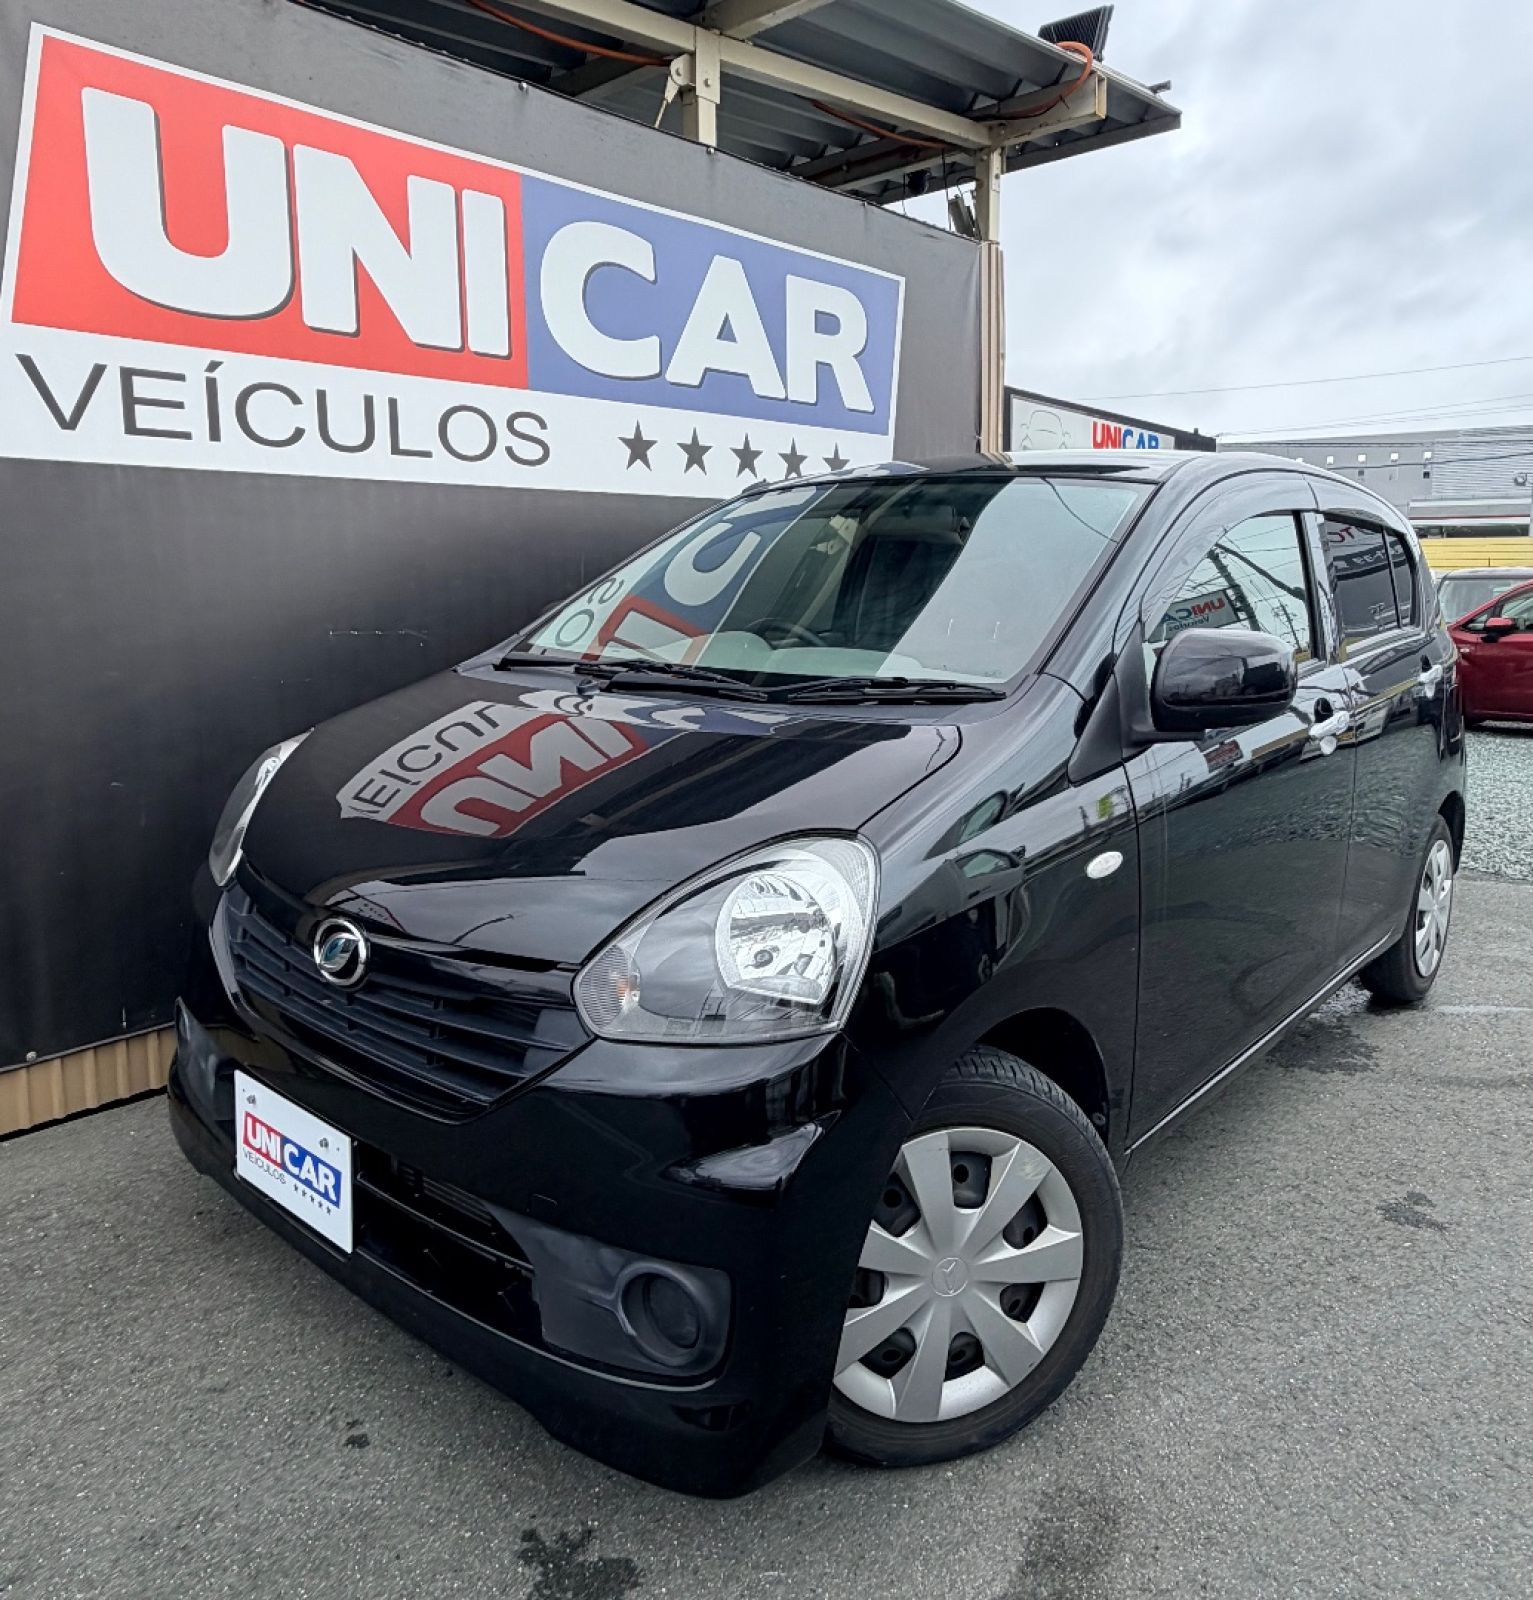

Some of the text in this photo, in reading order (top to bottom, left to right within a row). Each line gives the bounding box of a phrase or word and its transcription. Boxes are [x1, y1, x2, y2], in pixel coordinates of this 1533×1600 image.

[81, 86, 876, 414] UNICAR
[15, 353, 551, 467] VEÍCULOS
[246, 1116, 338, 1204] UNICAR
